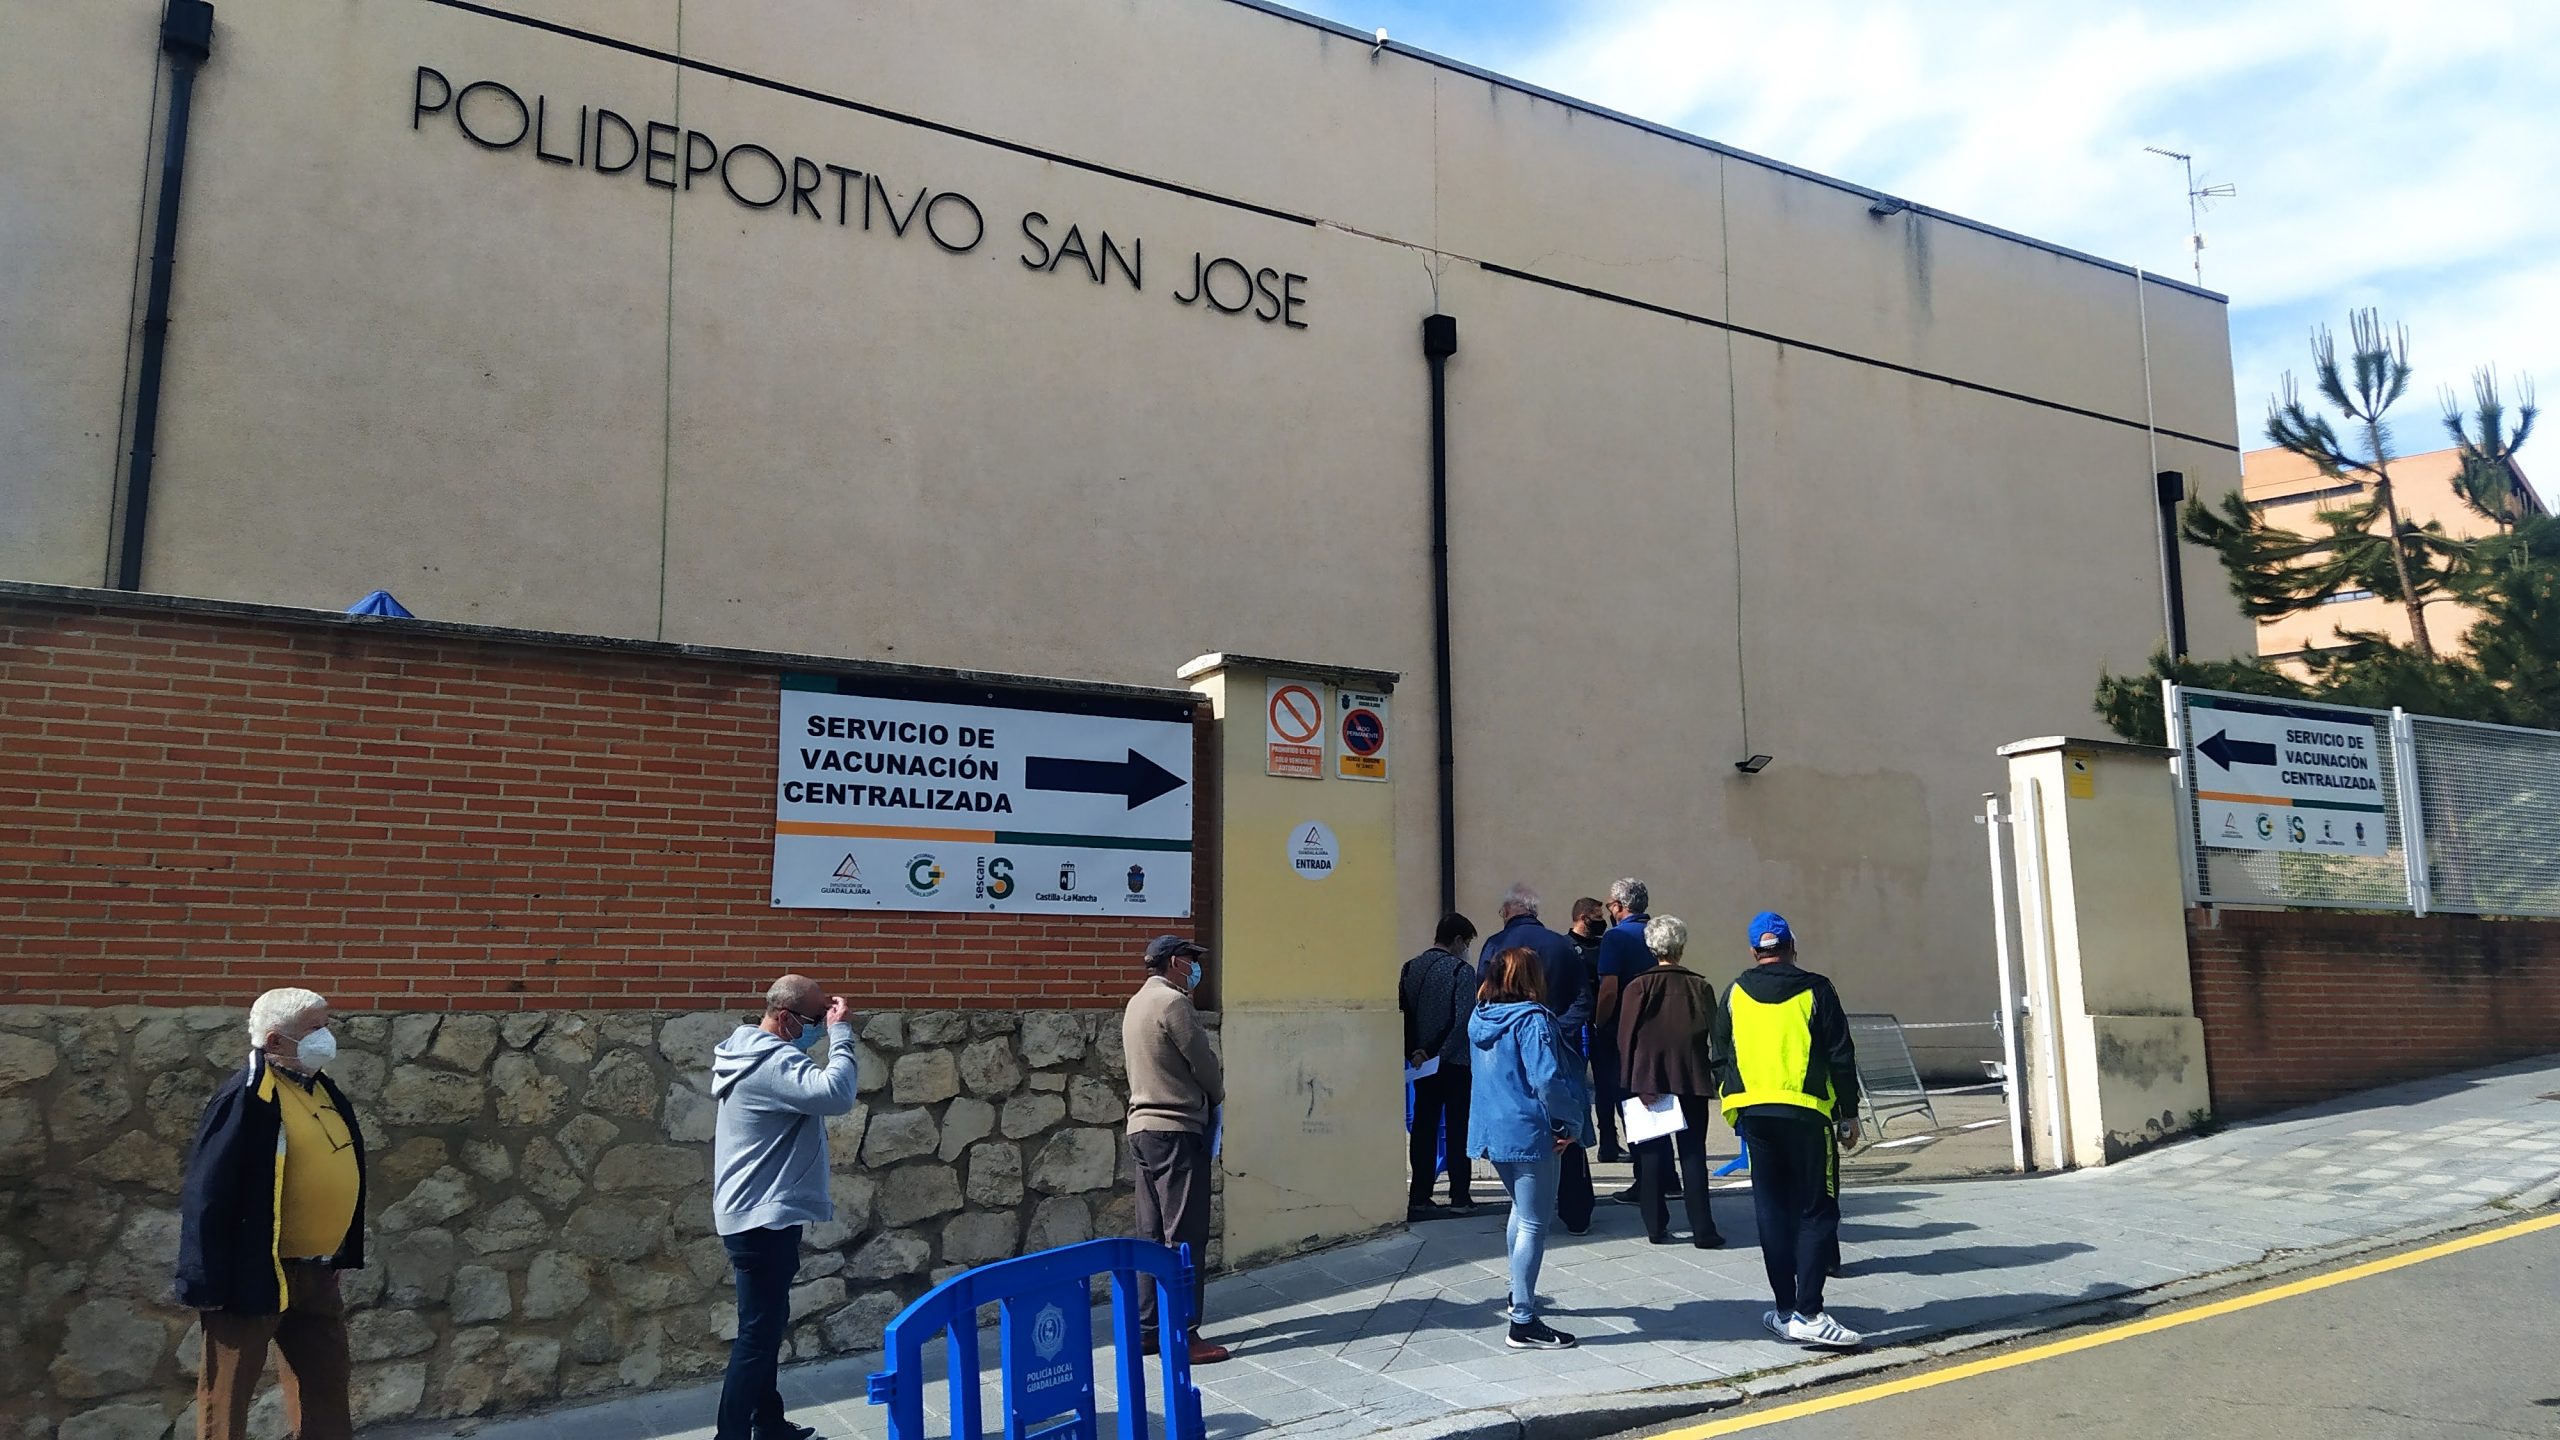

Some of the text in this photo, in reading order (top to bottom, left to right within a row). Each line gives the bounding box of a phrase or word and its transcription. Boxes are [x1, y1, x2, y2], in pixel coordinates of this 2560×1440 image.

[413, 65, 1309, 330] POLIDEPORTIVO SAN JOSE
[806, 714, 995, 750] SERVICIO DE
[2286, 729, 2364, 750] SERVICIO DE
[799, 747, 999, 781] VACUNACIÓN
[2285, 750, 2369, 770] VACUNACIÓN
[2281, 770, 2378, 791] CENTRALIZADA
[783, 780, 1013, 814] CENTRALIZADA
[1295, 858, 1332, 870] ENTRADA
[975, 856, 986, 899] sescam
[820, 887, 871, 895] GUADALAJARA
[1072, 893, 1098, 903] Mancha
[1053, 1363, 1073, 1375] LOCAL
[1027, 1372, 1073, 1392] GUADALAJARA
